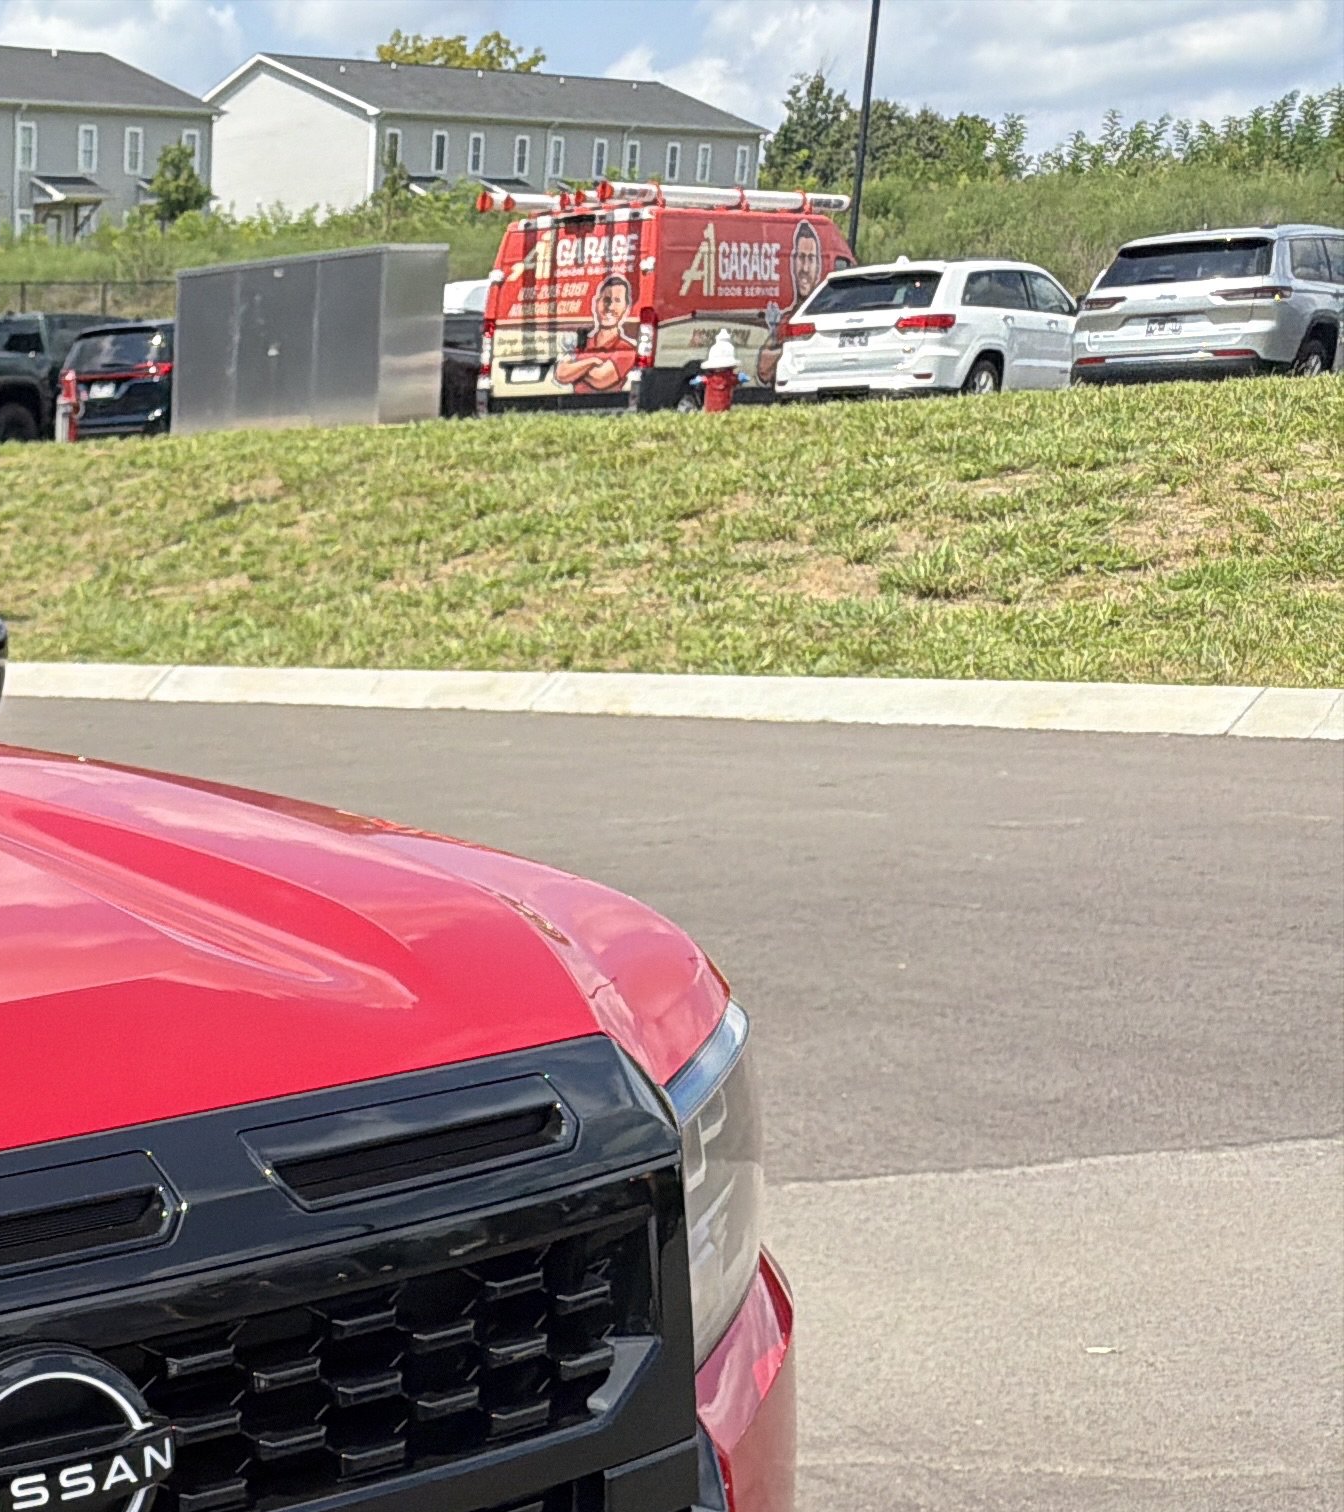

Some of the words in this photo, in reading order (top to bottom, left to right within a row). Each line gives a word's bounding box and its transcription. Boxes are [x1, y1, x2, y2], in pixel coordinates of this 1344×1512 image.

[556, 234, 639, 266] GARAGE
[718, 241, 781, 282] GARAGE
[744, 285, 781, 296] SERVICE
